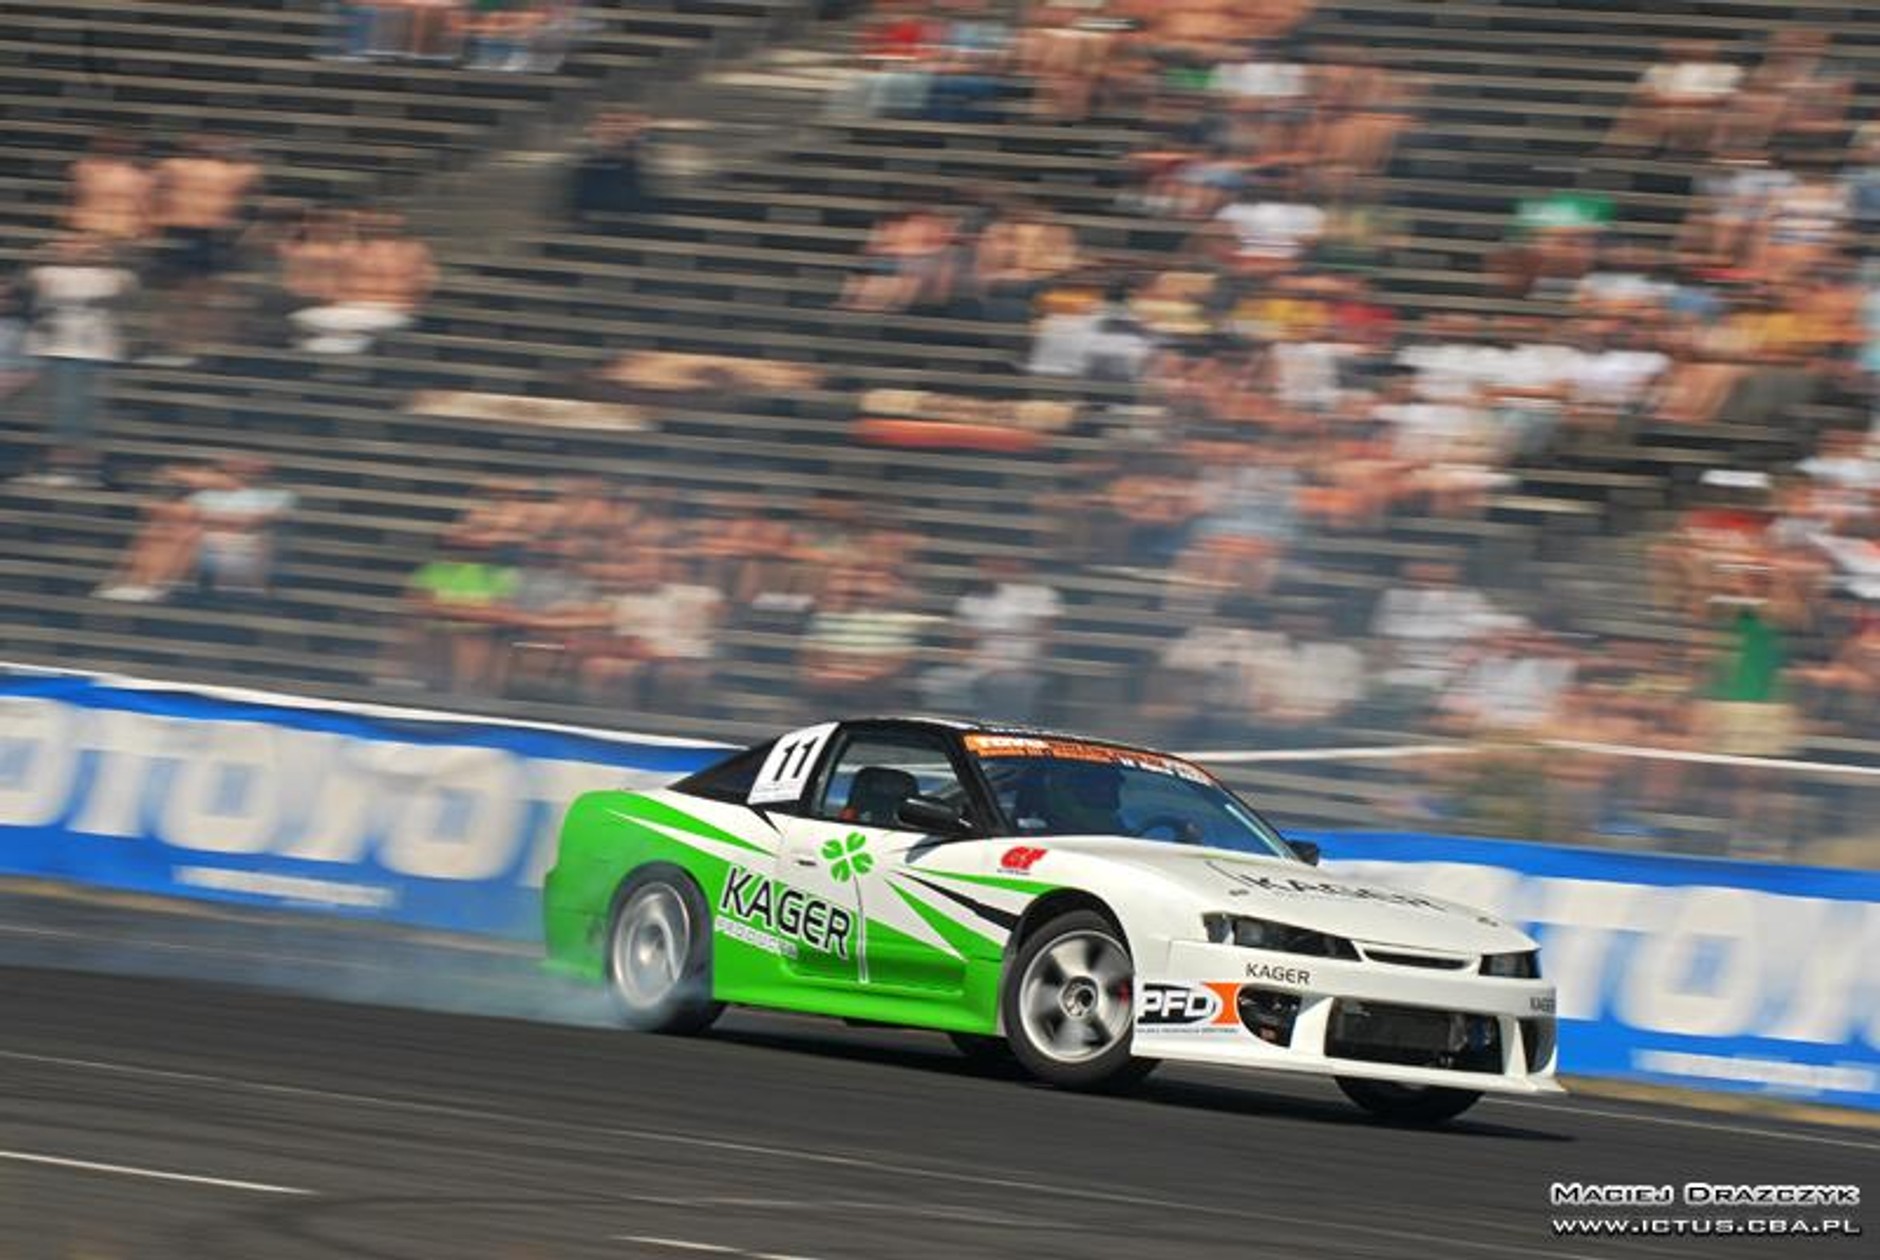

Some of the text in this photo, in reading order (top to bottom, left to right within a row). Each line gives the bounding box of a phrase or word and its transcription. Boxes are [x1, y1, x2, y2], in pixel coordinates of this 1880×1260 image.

[771, 735, 820, 782] 11
[719, 865, 851, 959] KAGER
[1245, 963, 1311, 985] KAGER
[1136, 986, 1218, 1022] PFD
